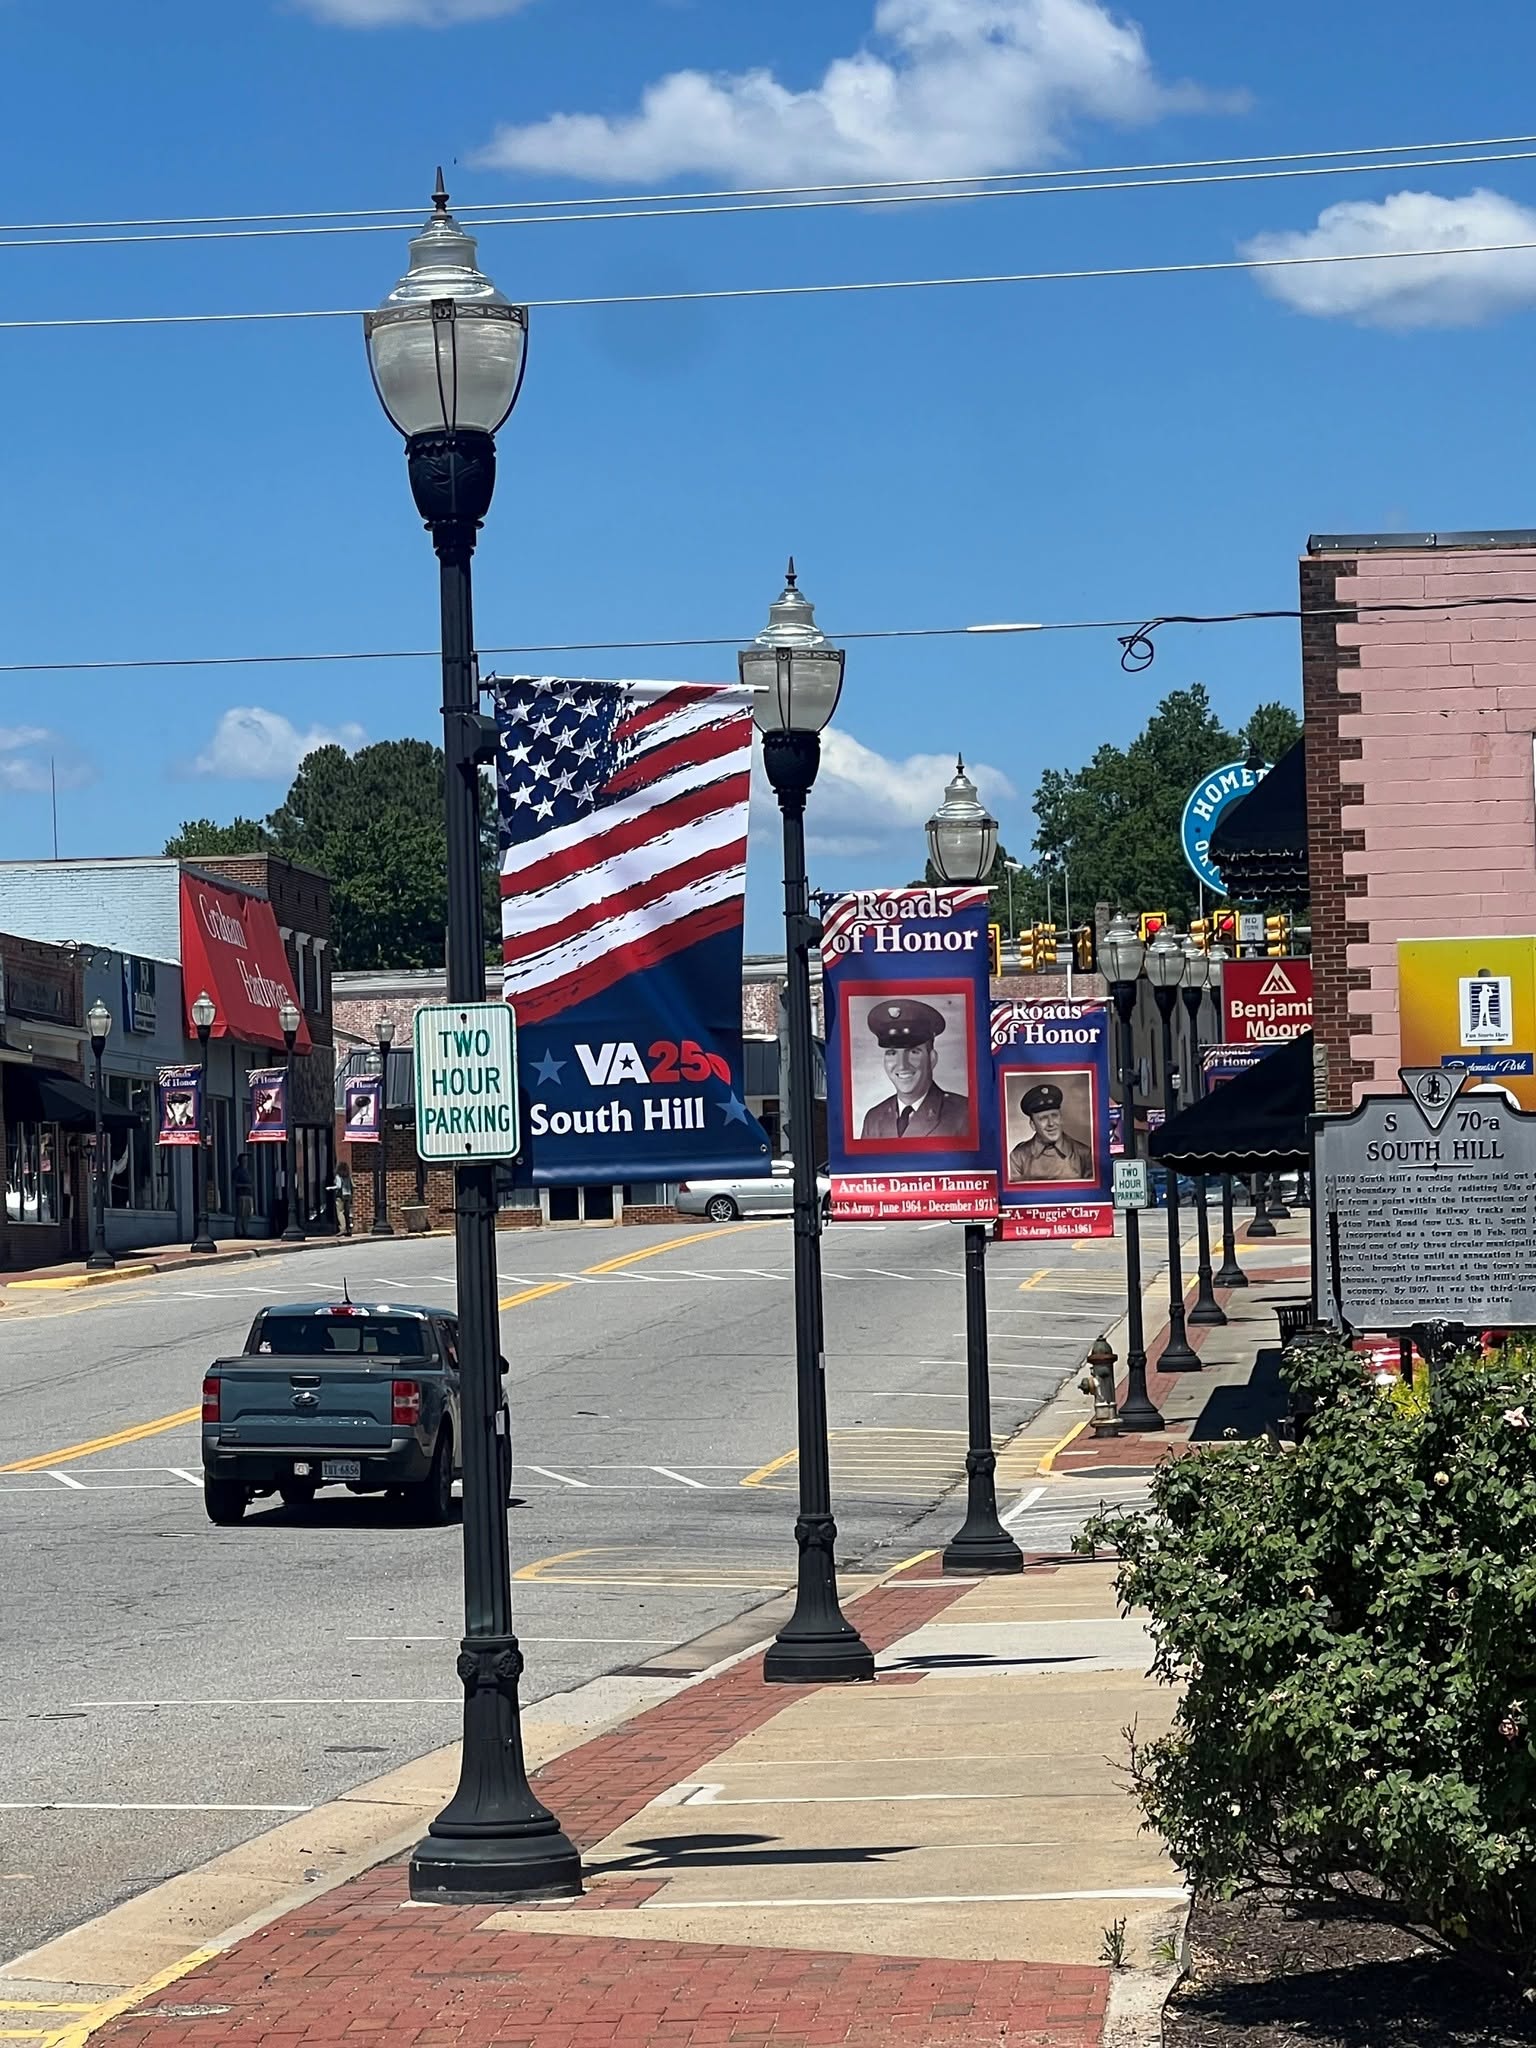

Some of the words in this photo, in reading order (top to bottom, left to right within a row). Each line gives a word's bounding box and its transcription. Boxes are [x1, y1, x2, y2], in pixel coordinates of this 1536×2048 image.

[1193, 768, 1269, 821] HOMET
[854, 889, 952, 920] Roads
[199, 893, 248, 950] Graham
[832, 924, 867, 953] of
[874, 924, 978, 953] Honor
[235, 958, 289, 1009] Hardware
[1012, 1001, 1082, 1020] Roads
[1231, 997, 1312, 1021] Benjami
[994, 1023, 1020, 1045] of
[1024, 1023, 1101, 1044] Honor
[1246, 1020, 1312, 1039] Moore
[438, 1029, 490, 1058] TWO
[1222, 1058, 1260, 1067] Honor
[173, 1078, 197, 1087] Honor
[432, 1067, 500, 1096] HOUR
[425, 1104, 510, 1135] PARKING
[531, 1101, 633, 1136] South
[643, 1097, 705, 1131] Hill
[1384, 1112, 1398, 1132] S
[1366, 1140, 1441, 1162] SOUTH
[1453, 1139, 1505, 1160] HILL
[1121, 1168, 1138, 1177] TWO
[1360, 1174, 1385, 1182] South
[839, 1180, 886, 1193] Archie
[889, 1178, 936, 1192] Daniel
[939, 1177, 989, 1191] Tanner
[1119, 1180, 1141, 1188] HOUR
[1356, 1186, 1396, 1195] boundary
[1117, 1191, 1144, 1201] PARKING
[1382, 1198, 1405, 1206] point
[851, 1201, 875, 1217] Army
[878, 1202, 900, 1216] June
[902, 1201, 922, 1214] 1964
[929, 1199, 972, 1213] December
[1071, 1207, 1100, 1220] Clary
[1368, 1208, 1383, 1216] and
[1392, 1207, 1428, 1215] Danville
[1477, 1205, 1503, 1213] tracks
[1511, 1205, 1526, 1213] and
[1396, 1218, 1417, 1226] Road
[1500, 1217, 1526, 1225] South
[1015, 1226, 1029, 1235] US
[1029, 1225, 1051, 1238] Army
[1346, 1231, 1401, 1240] incorporated
[1431, 1229, 1452, 1237] town
[1400, 1241, 1419, 1250] only
[1423, 1241, 1446, 1249] three
[1486, 1238, 1536, 1248] municipalit
[1358, 1252, 1388, 1260] United
[1372, 1263, 1406, 1273] brought
[1465, 1273, 1490, 1281] South
[1490, 1283, 1536, 1292] third-larg
[1380, 1297, 1414, 1305] tobacco
[1468, 1295, 1482, 1303] the
